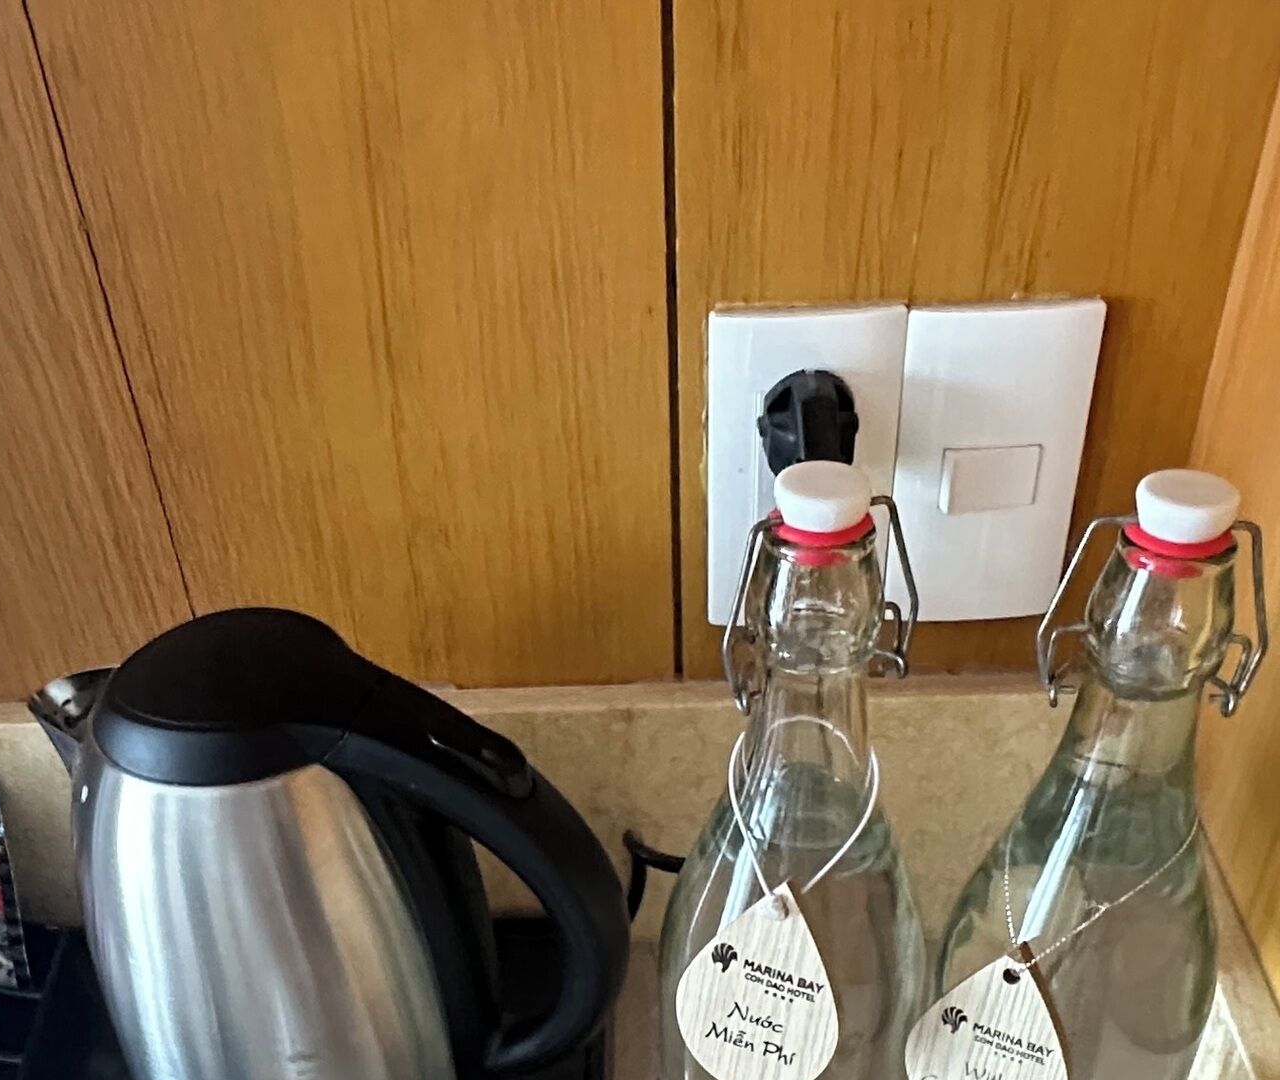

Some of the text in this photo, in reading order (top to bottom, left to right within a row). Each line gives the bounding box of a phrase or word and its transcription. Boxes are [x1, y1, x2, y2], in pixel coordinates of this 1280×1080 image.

[743, 959, 825, 994] MARINA BAY
[744, 972, 816, 1003] CON DAO HOTEL
[762, 1040, 797, 1066] Phí
[972, 1022, 1055, 1058] MARINA BAY
[973, 1034, 1046, 1066] CON DAO HOTEL
